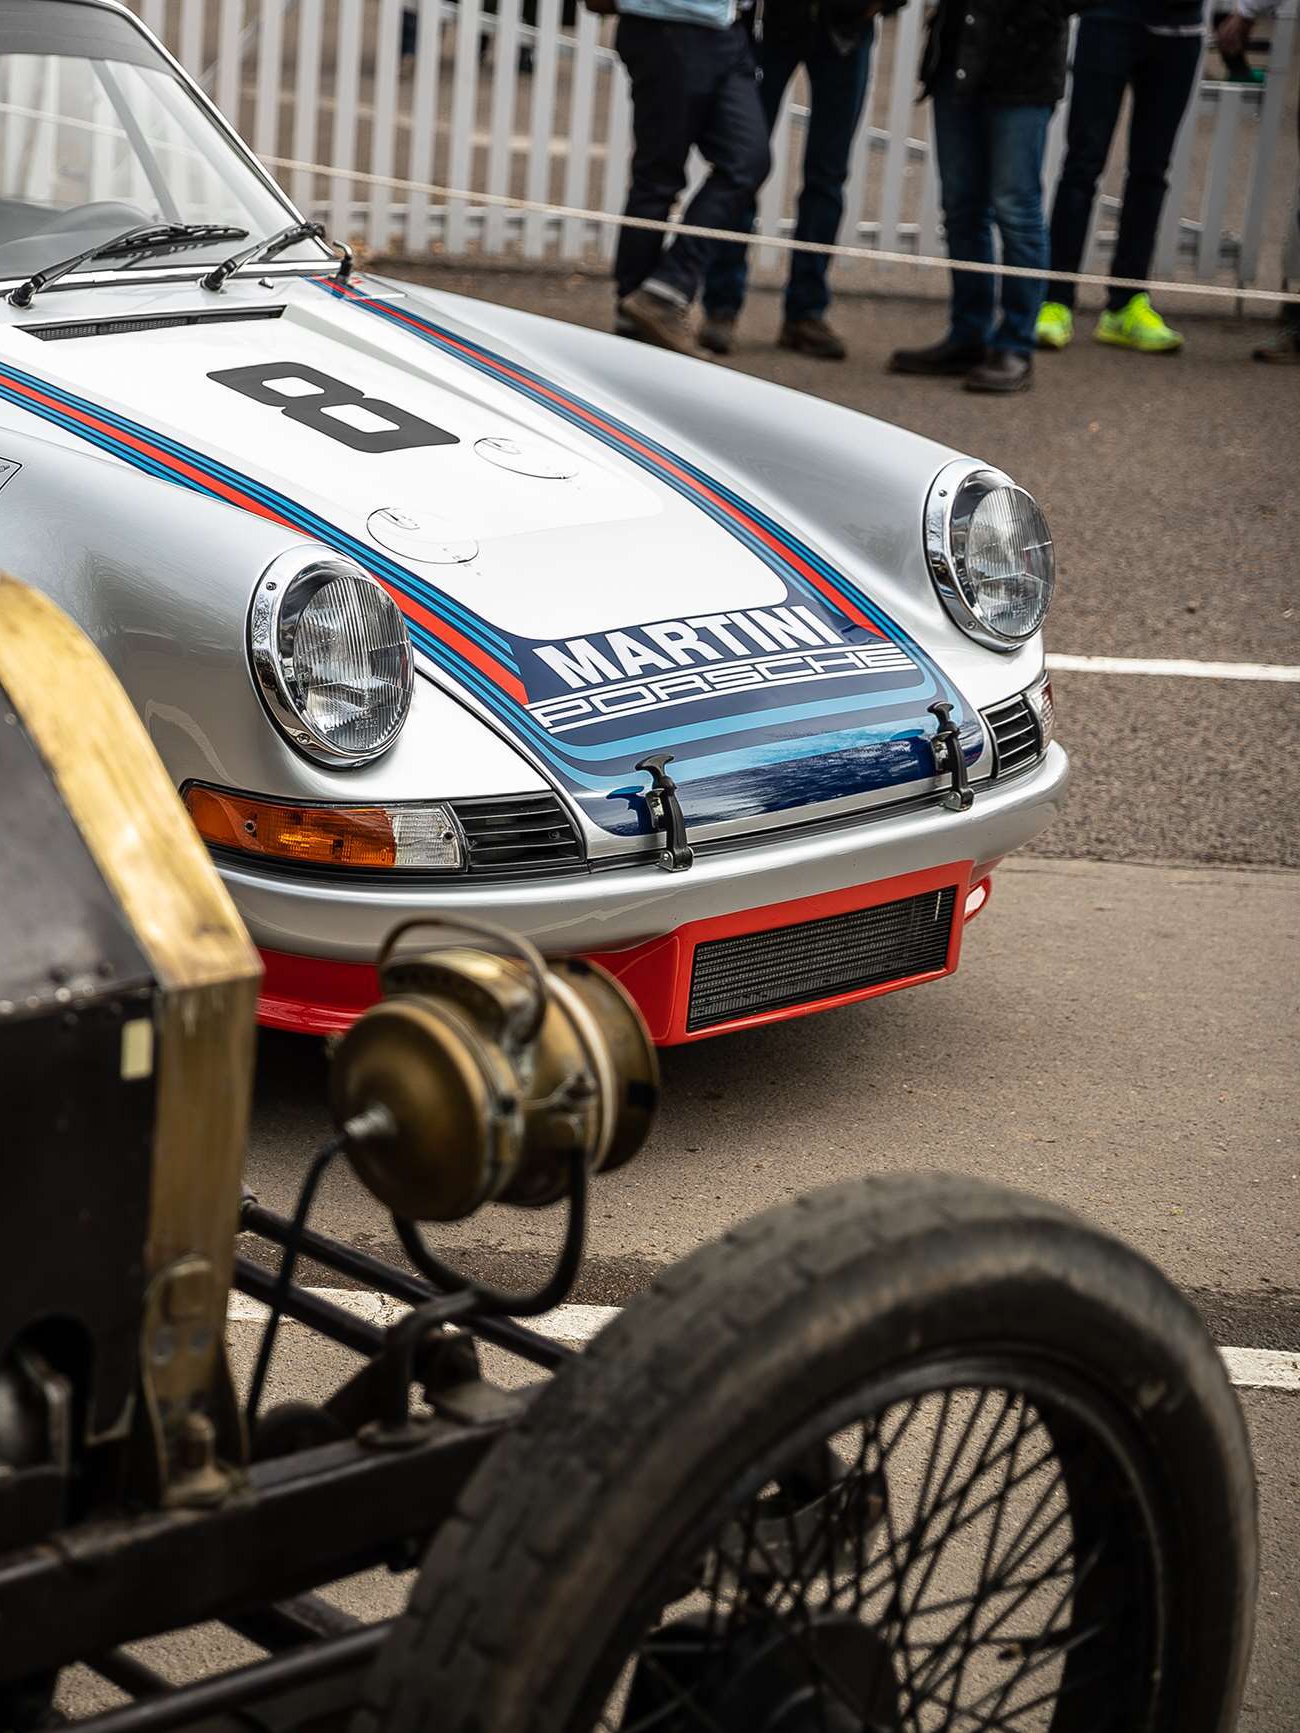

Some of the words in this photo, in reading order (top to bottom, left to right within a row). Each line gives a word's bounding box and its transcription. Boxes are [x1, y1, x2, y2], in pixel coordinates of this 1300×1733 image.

[206, 361, 461, 453] 8
[530, 645, 912, 728] PORSCHE
[532, 605, 845, 689] MARTINI
